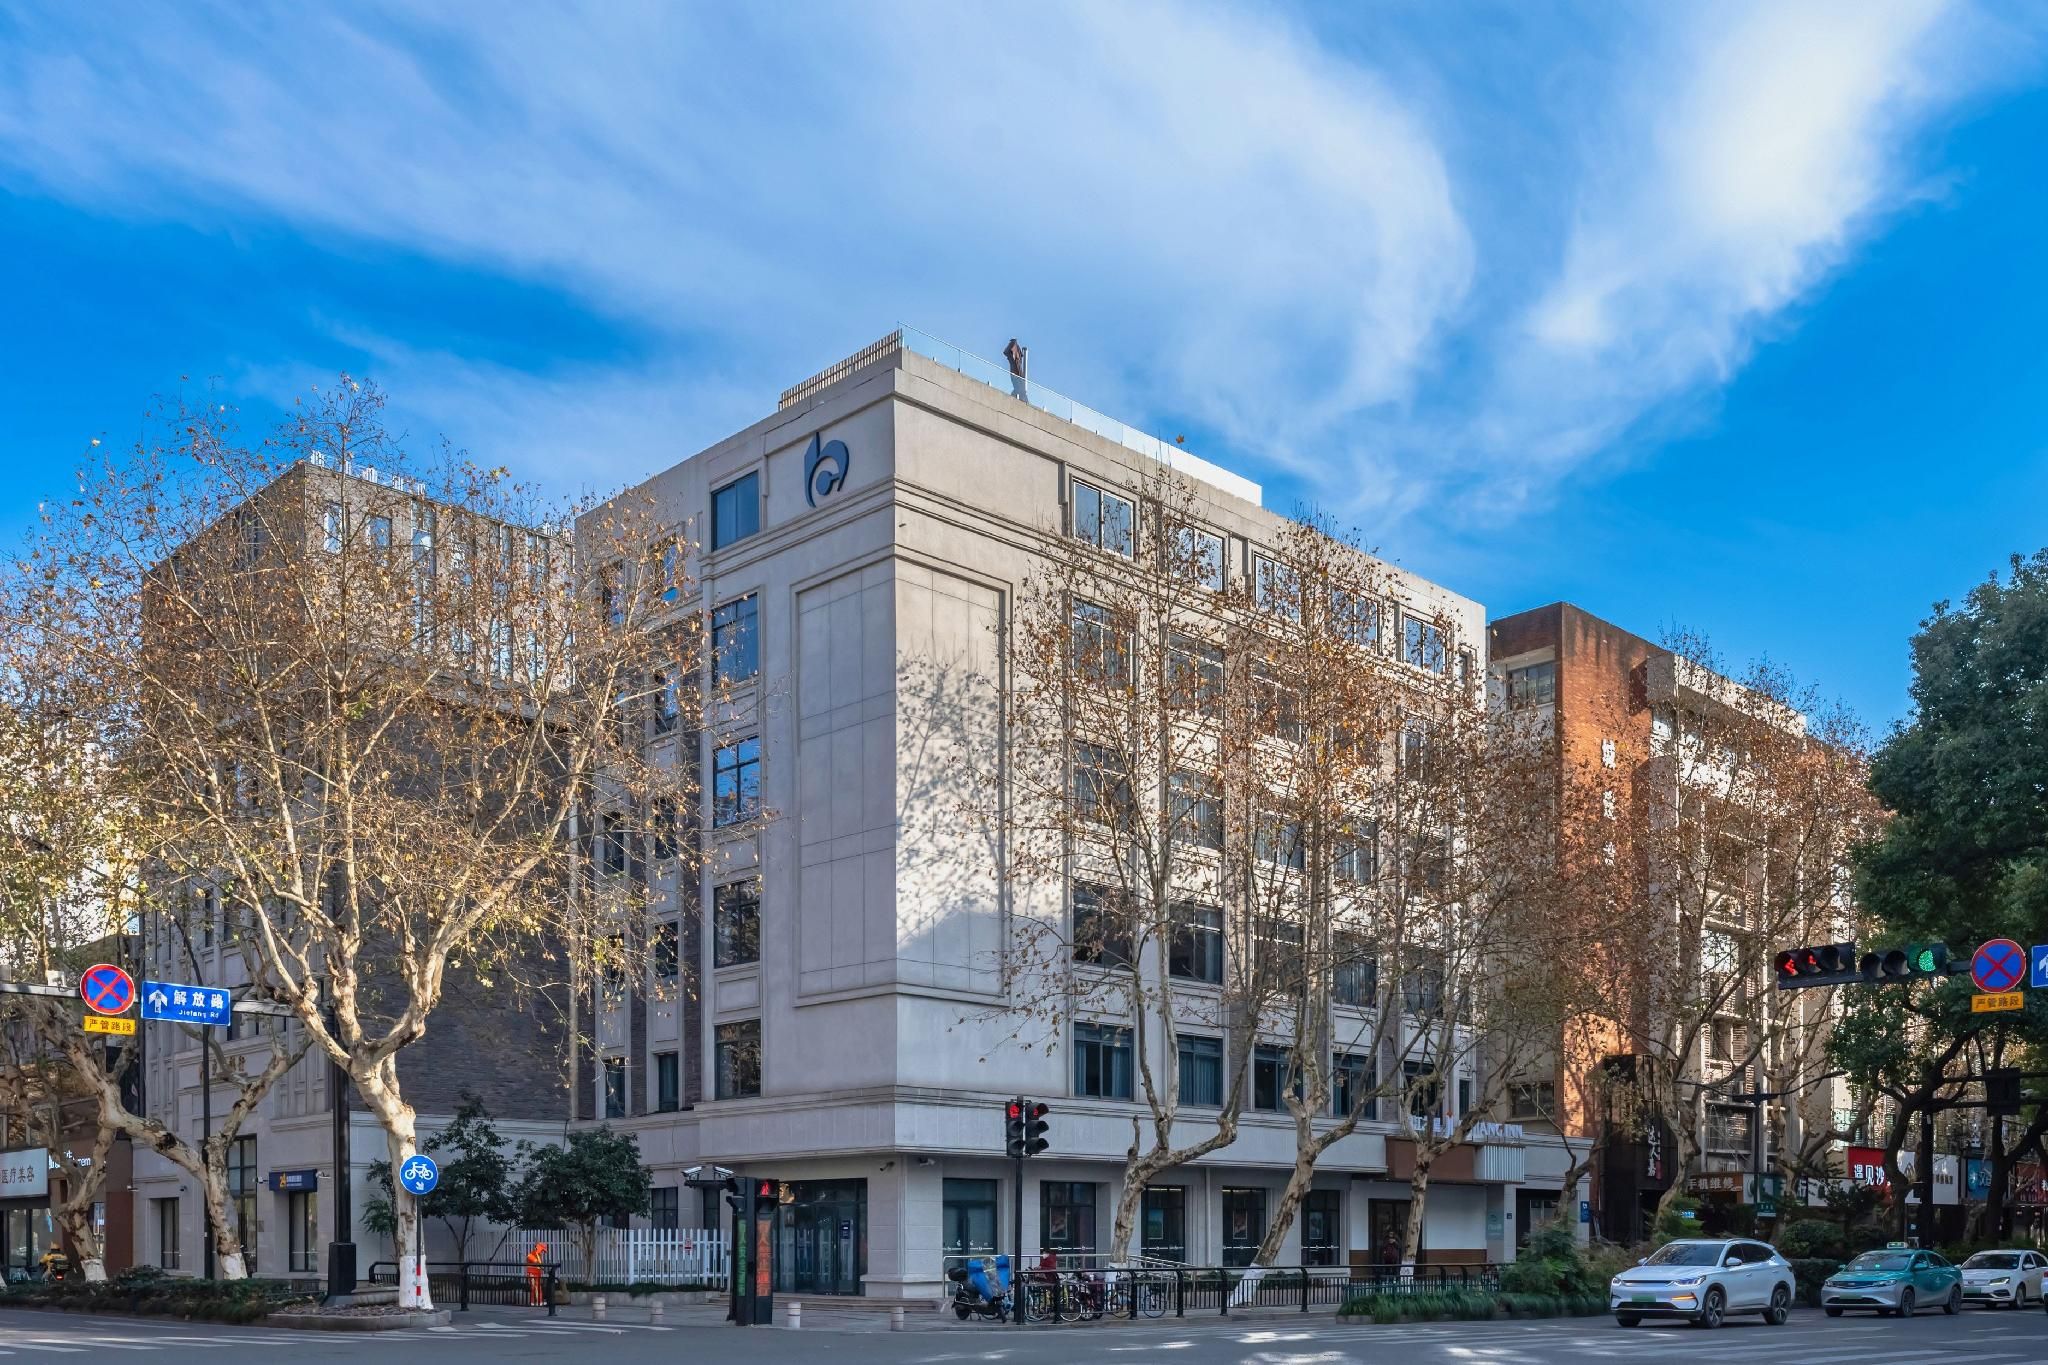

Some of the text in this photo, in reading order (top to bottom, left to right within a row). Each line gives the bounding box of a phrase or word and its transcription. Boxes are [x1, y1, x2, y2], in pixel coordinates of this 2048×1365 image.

[173, 989, 224, 1009] 解放路
[1975, 995, 2019, 1009] 严管路段
[179, 1009, 207, 1018] Jiefang
[88, 1018, 133, 1032] 严管路段
[0, 1164, 35, 1185] 医疗美容
[1688, 1177, 1735, 1190] 手机维修
